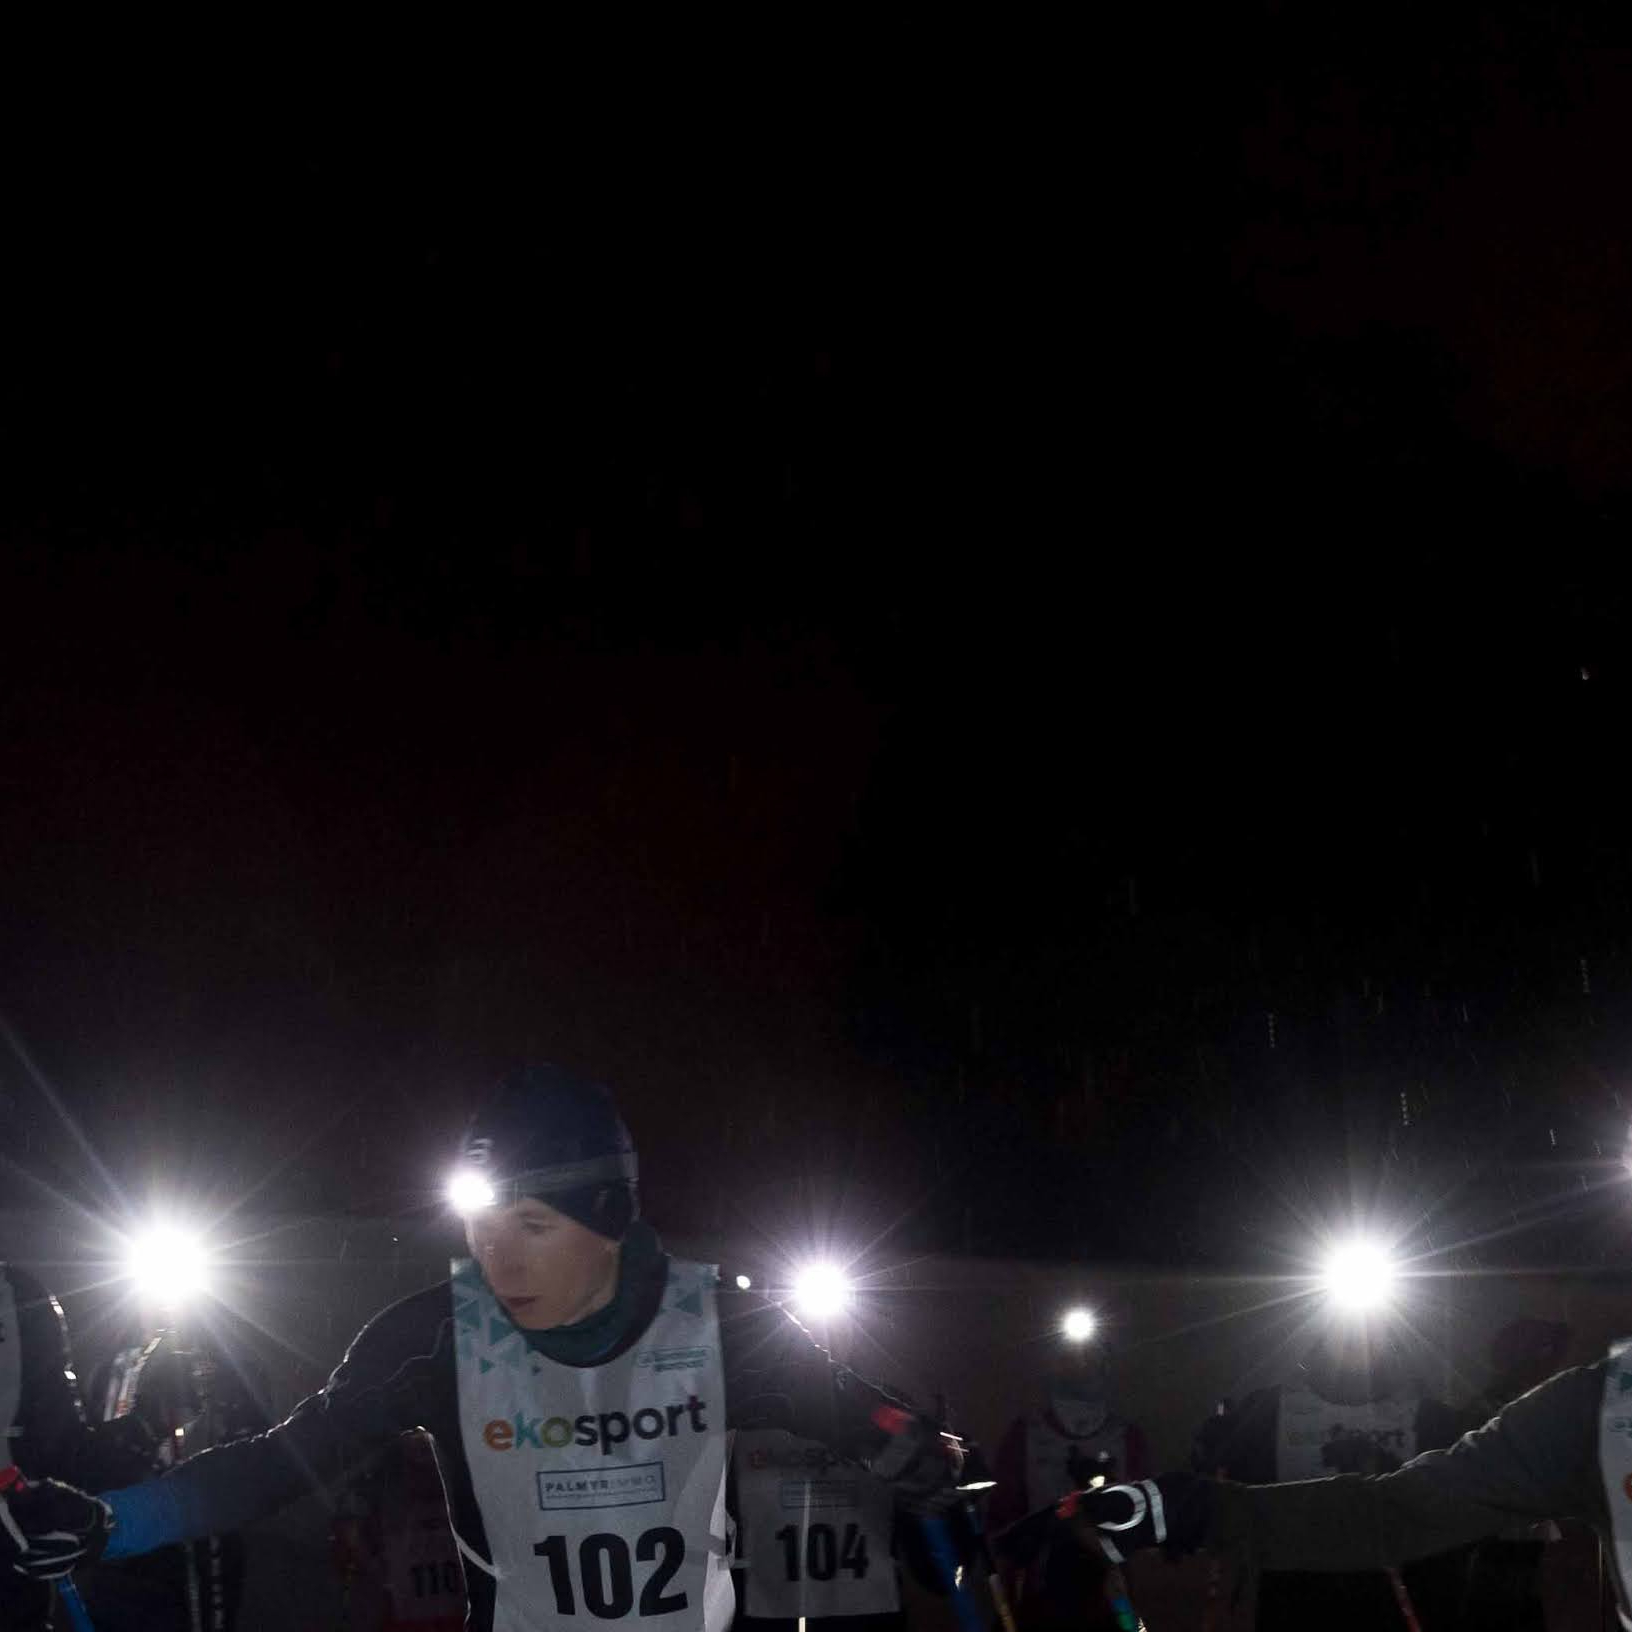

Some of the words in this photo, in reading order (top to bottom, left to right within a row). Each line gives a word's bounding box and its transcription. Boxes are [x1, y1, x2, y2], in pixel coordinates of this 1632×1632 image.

[483, 1395, 707, 1456] ekosport
[532, 1526, 688, 1620] 102
[775, 1523, 869, 1582] 104
